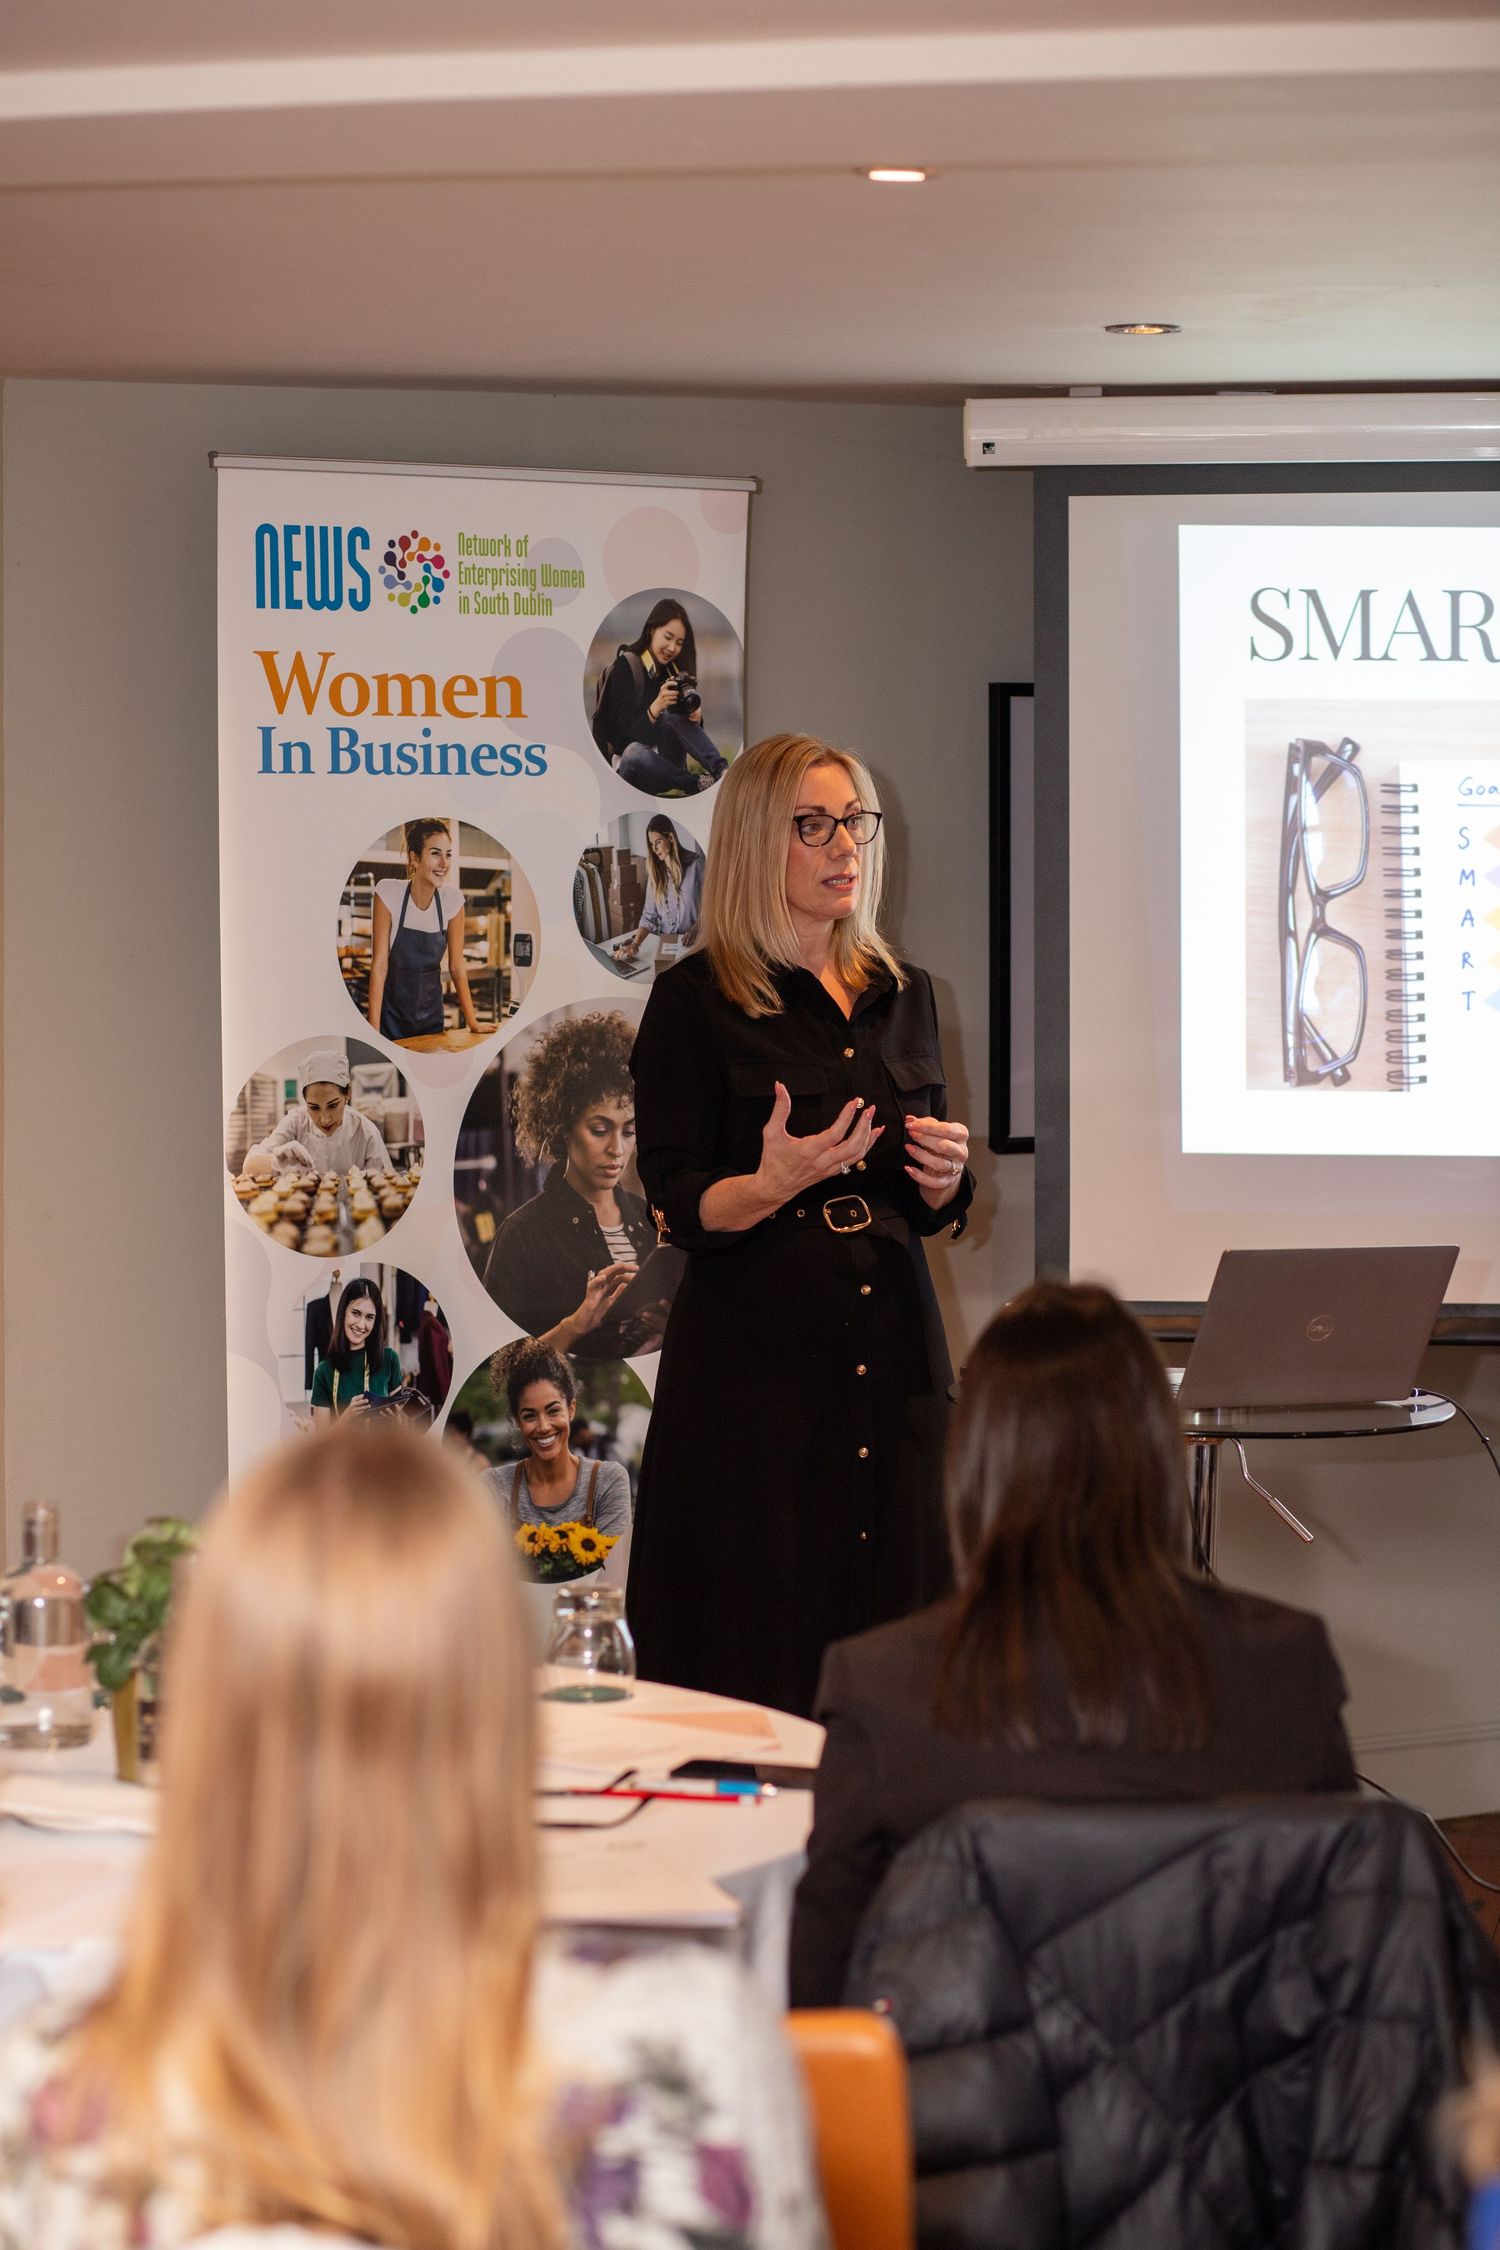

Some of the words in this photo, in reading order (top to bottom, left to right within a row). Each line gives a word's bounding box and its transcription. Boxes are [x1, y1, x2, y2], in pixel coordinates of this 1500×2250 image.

[458, 531, 511, 557] Network
[515, 534, 529, 558] of
[255, 523, 371, 612] NEWS
[458, 560, 537, 592] Enterprising
[541, 562, 585, 589] Women
[458, 590, 470, 615] in
[474, 590, 509, 616] South
[513, 591, 553, 617] Dublin
[253, 651, 529, 719] Women
[257, 726, 316, 775] In
[326, 727, 548, 778] Business
[1458, 826, 1470, 850] S
[1459, 868, 1476, 887] M
[1461, 908, 1475, 928] A
[1462, 951, 1475, 970] R
[1461, 990, 1477, 1011] T
